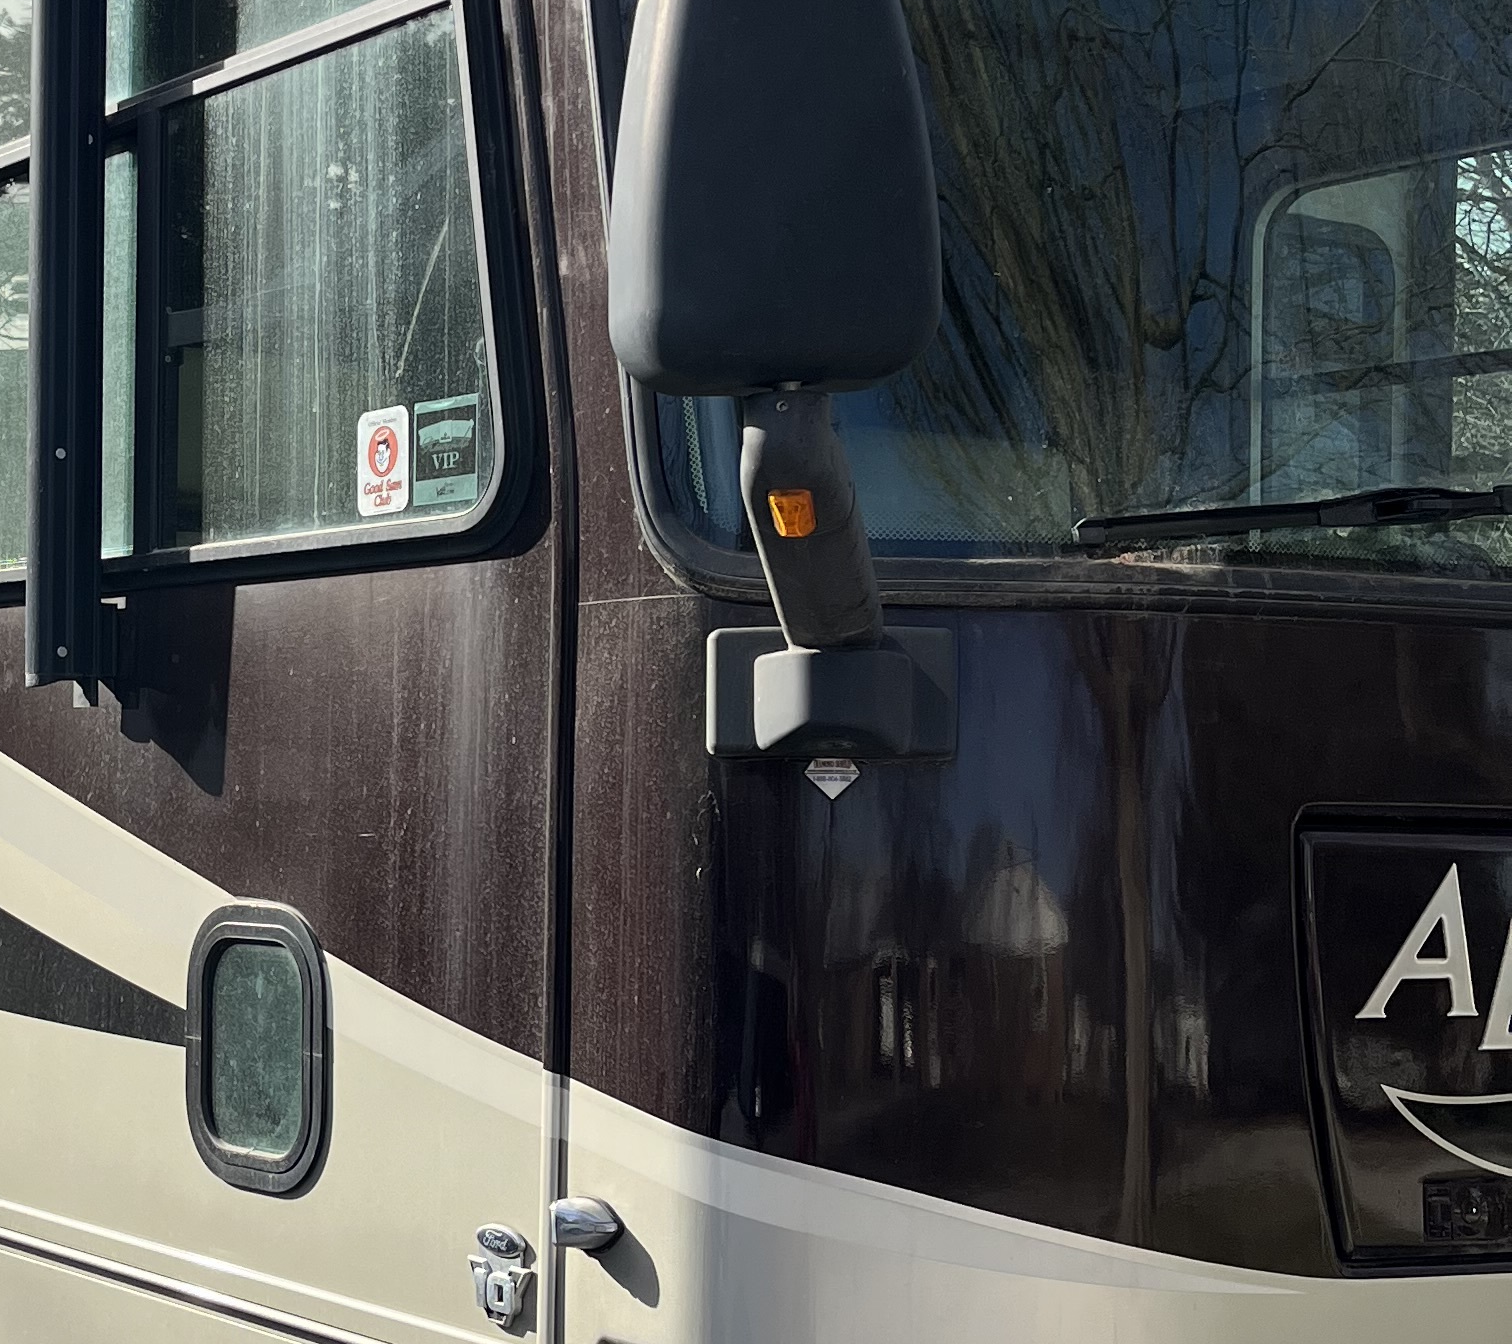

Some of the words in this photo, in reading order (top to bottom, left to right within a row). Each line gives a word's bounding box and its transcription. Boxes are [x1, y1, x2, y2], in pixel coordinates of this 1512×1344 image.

[431, 451, 459, 470] VIP
[364, 479, 384, 495] Good
[374, 493, 391, 507] Club
[482, 1229, 508, 1252] Ford
